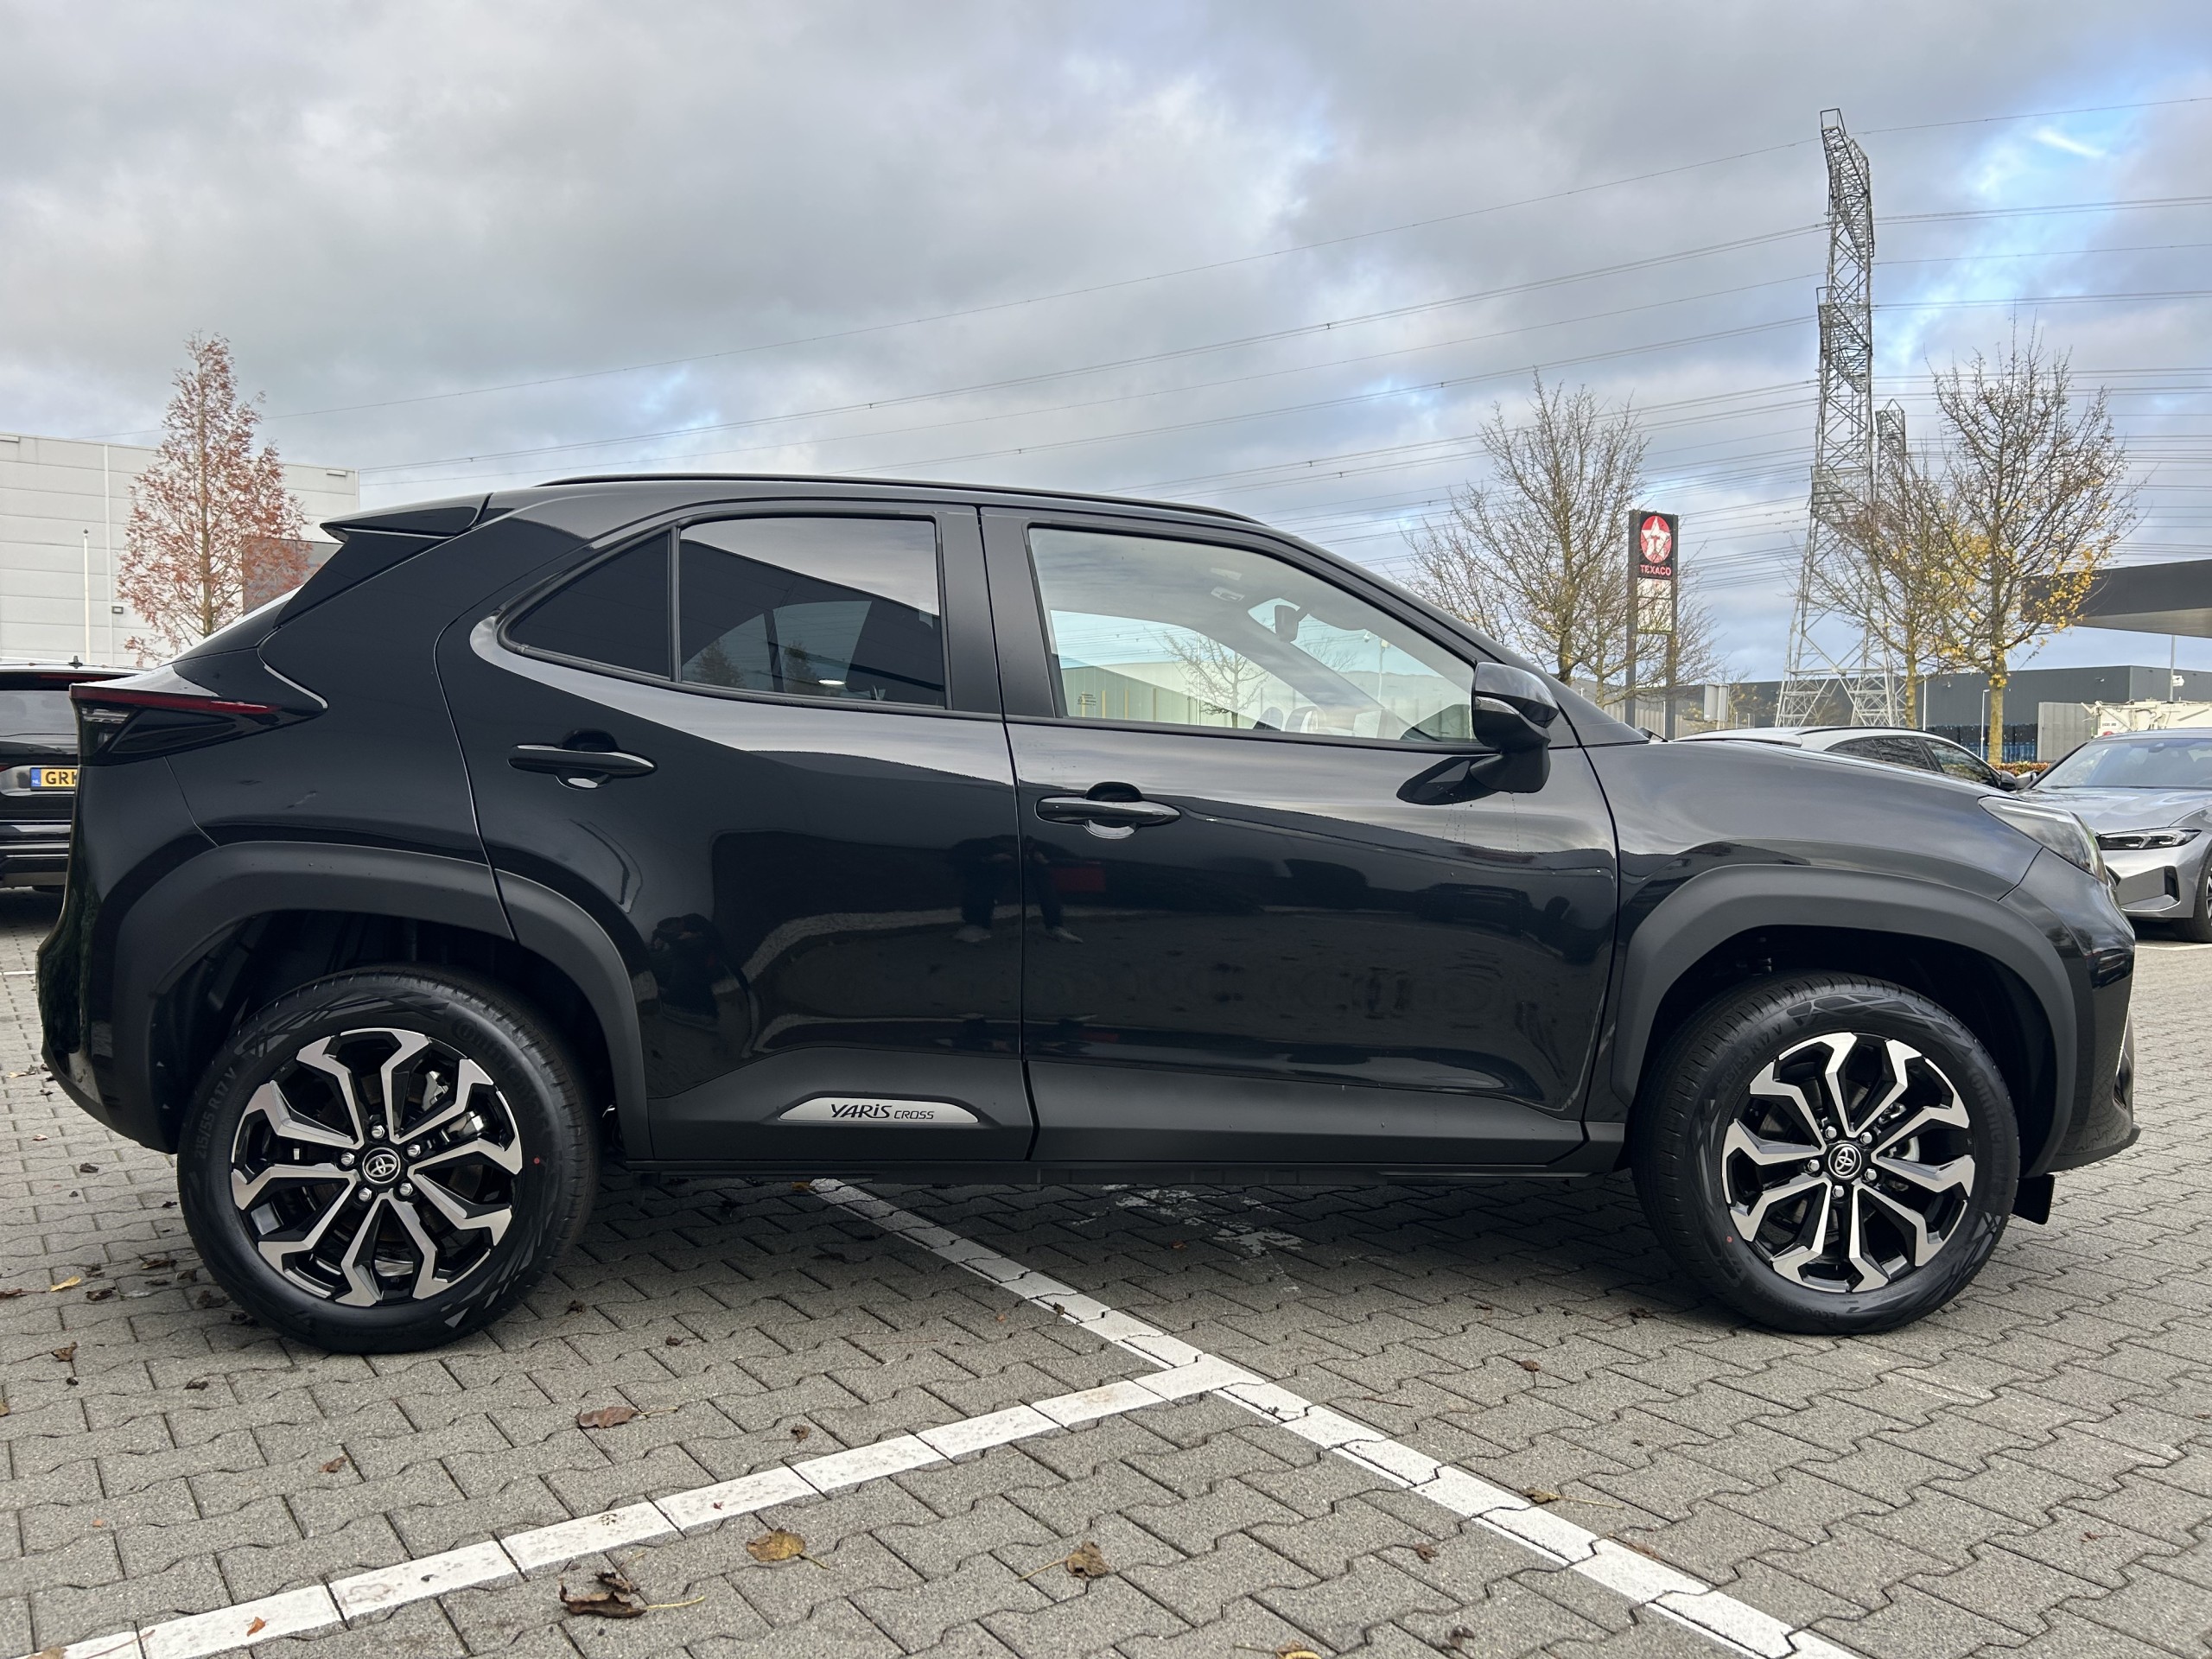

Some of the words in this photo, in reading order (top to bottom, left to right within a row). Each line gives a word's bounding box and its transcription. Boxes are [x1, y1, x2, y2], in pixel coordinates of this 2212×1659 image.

[1640, 564, 1672, 576] TEXACO
[224, 1066, 237, 1080] V
[214, 1081, 229, 1096] 17
[208, 1097, 221, 1109] R
[893, 1109, 935, 1120] CROSS
[194, 1111, 215, 1159] 215/55
